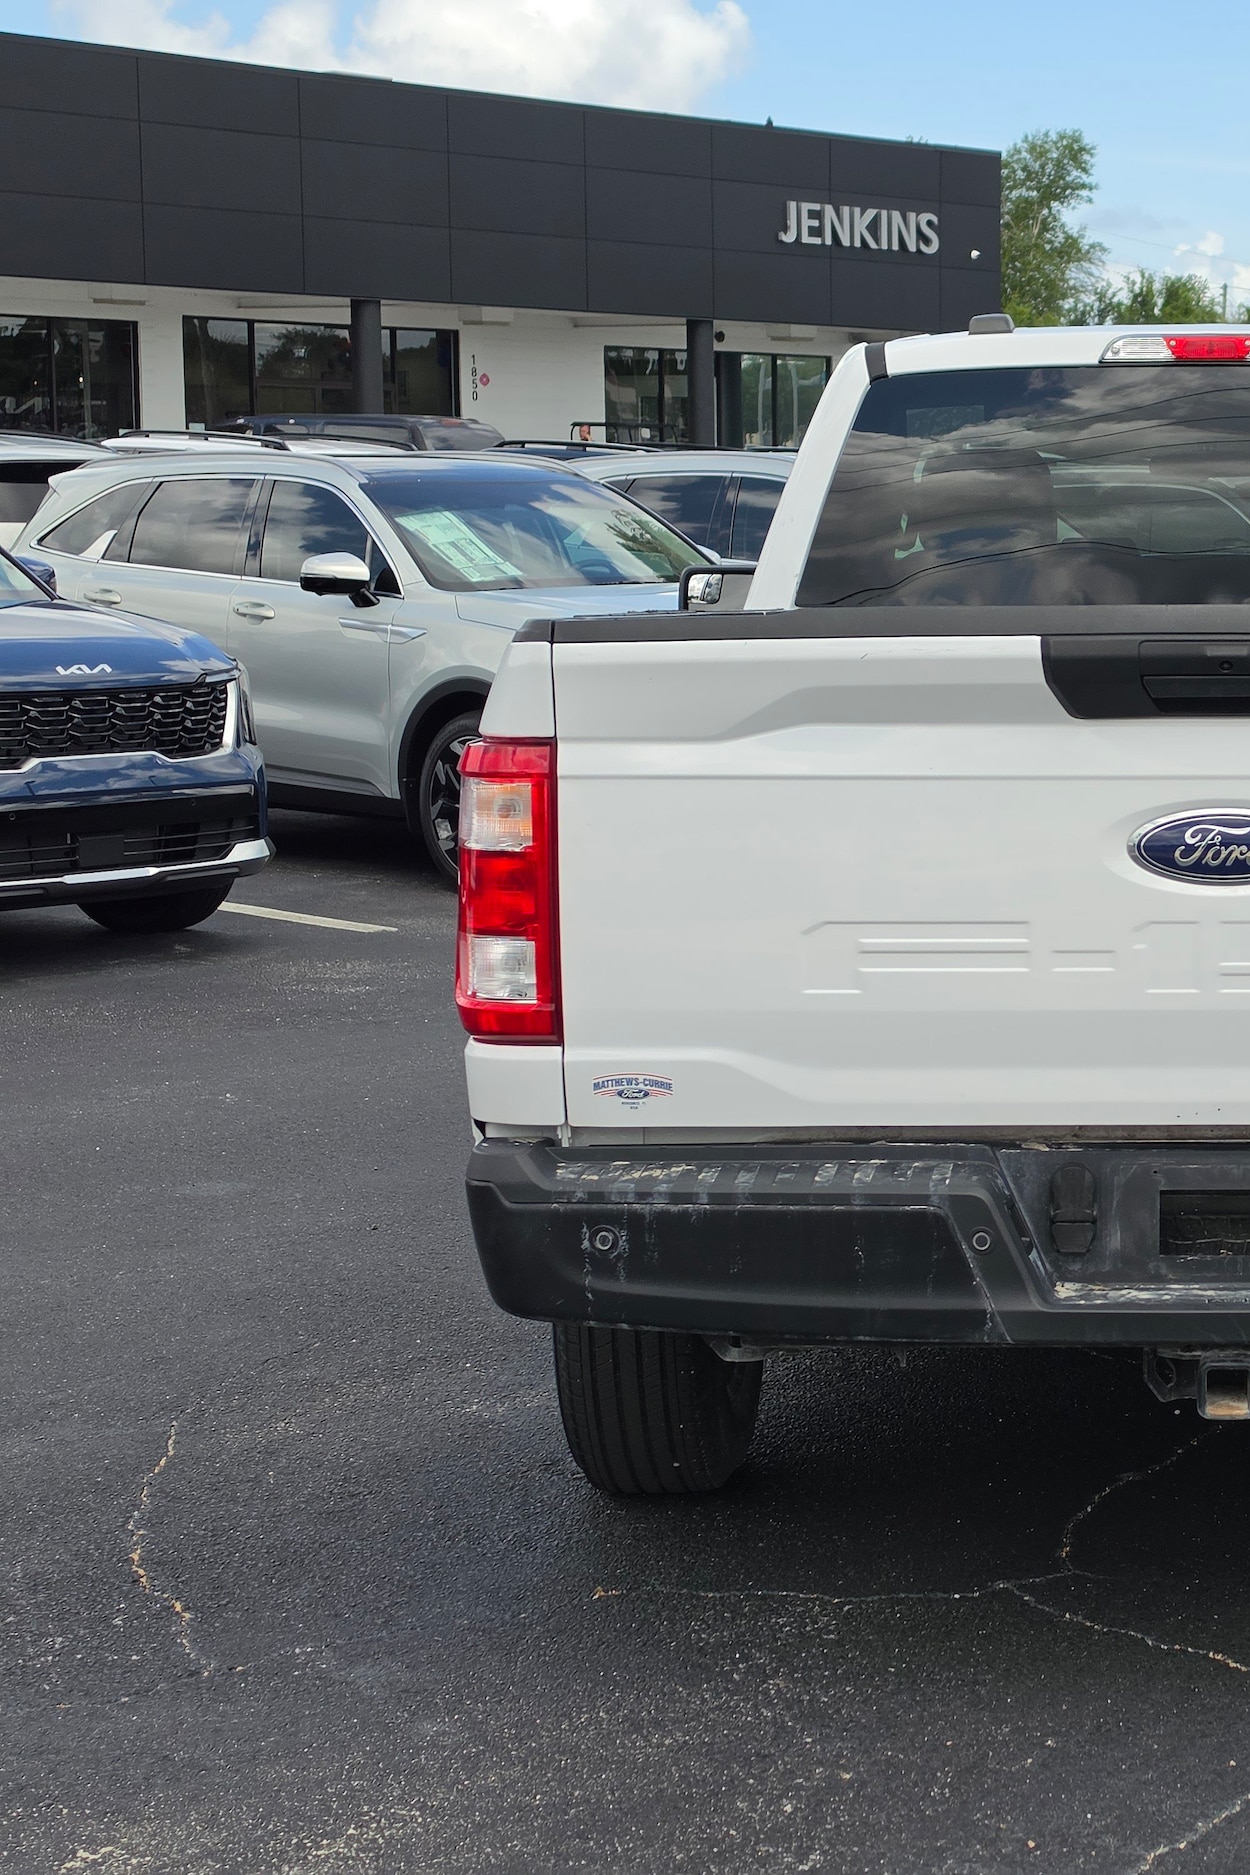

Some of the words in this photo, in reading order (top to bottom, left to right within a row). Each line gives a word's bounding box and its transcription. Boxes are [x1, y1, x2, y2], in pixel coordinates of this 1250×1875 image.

[778, 200, 940, 254] JENKINS
[593, 1077, 673, 1091] MATTHEWS-CURRIE
[622, 1089, 646, 1098] Ford
